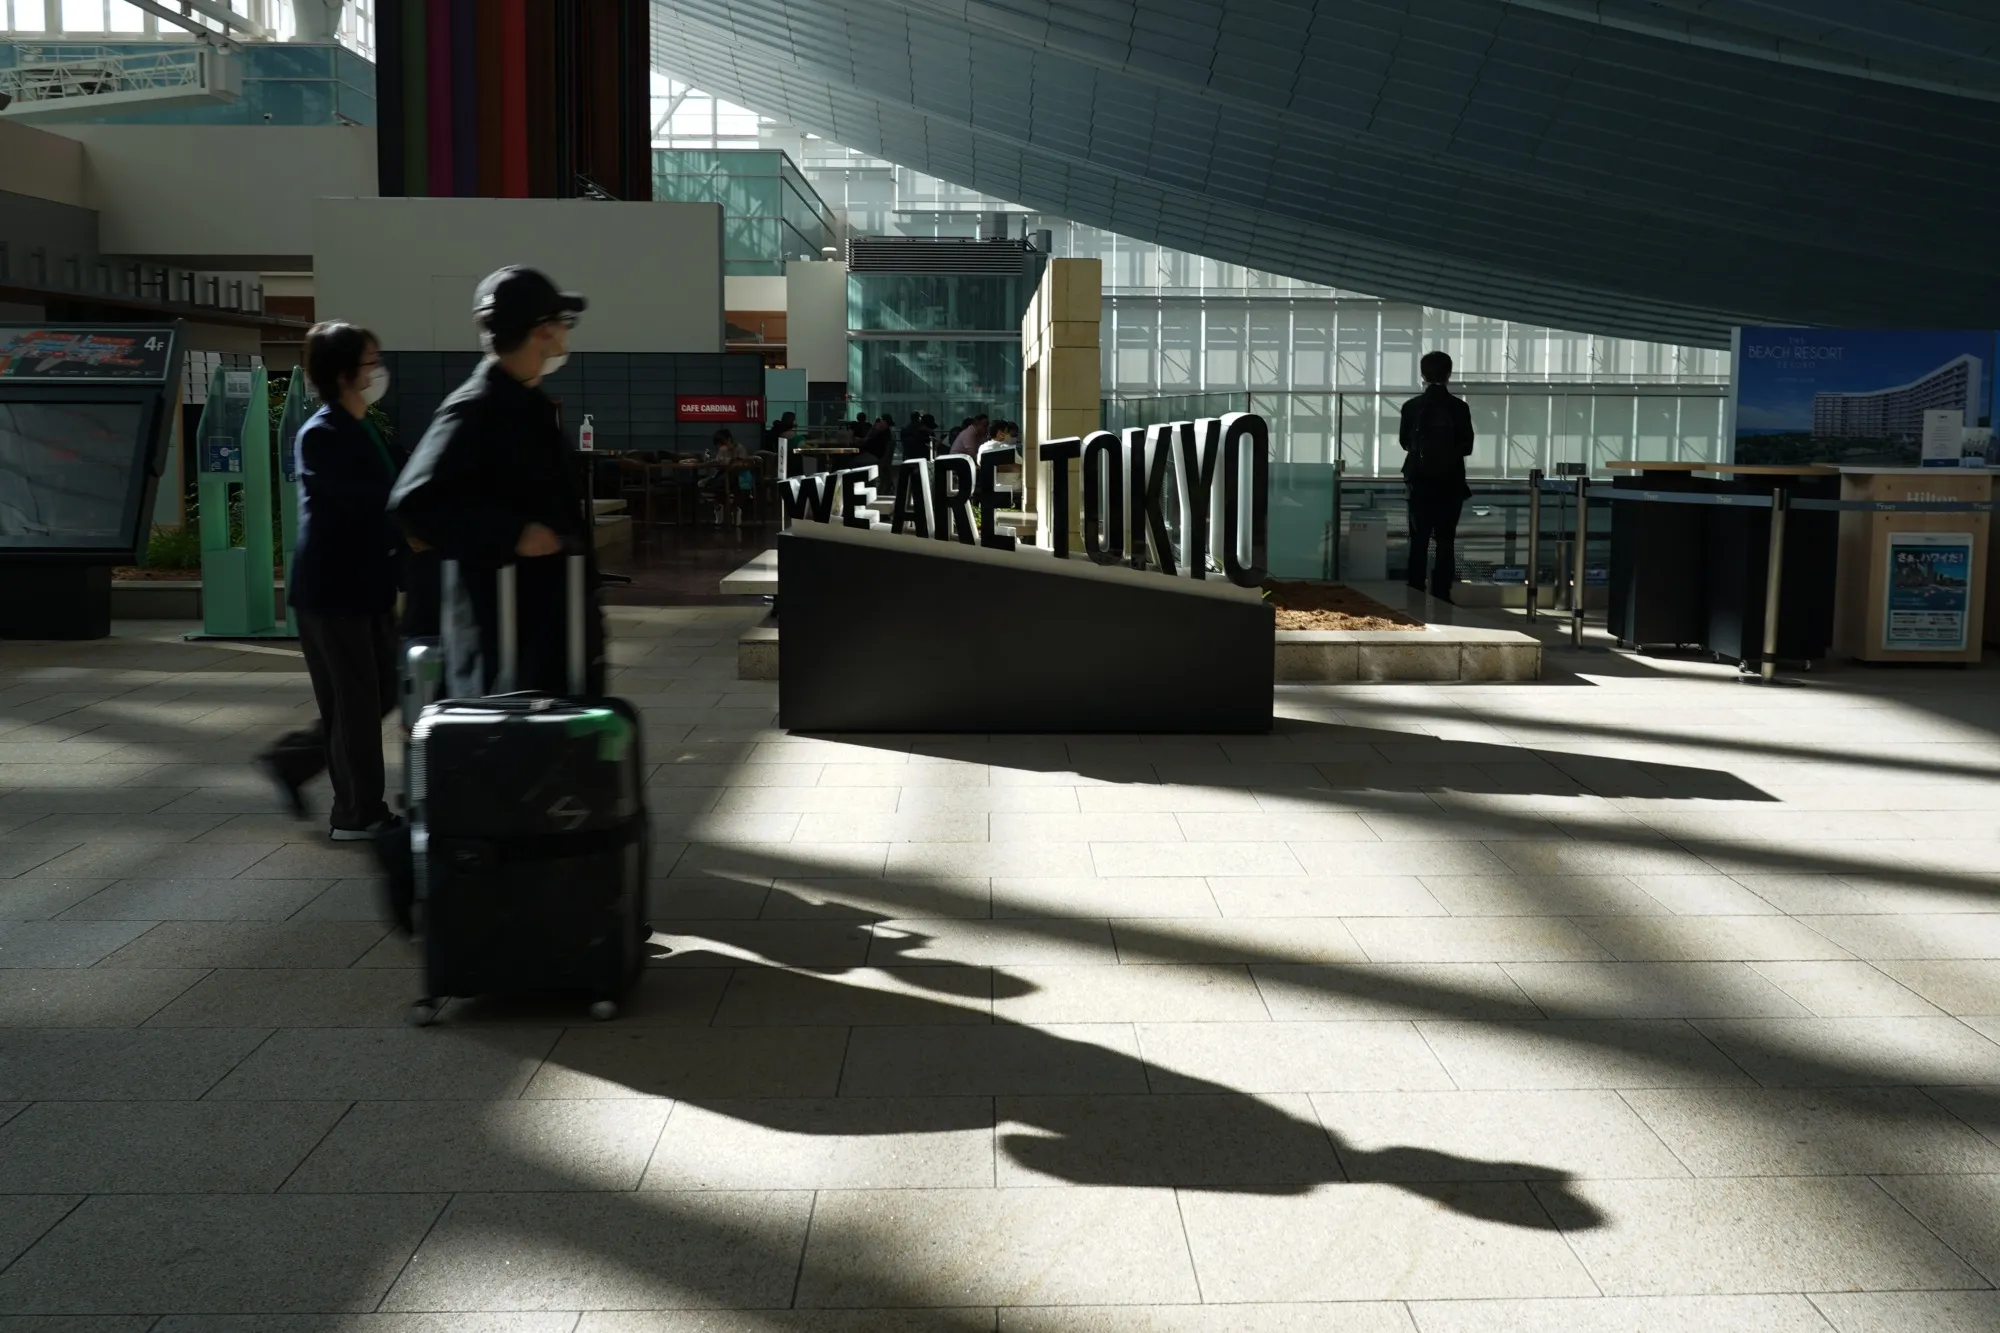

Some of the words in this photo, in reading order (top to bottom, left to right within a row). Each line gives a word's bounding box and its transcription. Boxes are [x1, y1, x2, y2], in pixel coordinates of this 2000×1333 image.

[144, 336, 164, 352] 4F
[1789, 336, 1807, 345] THE
[1748, 345, 1790, 359] BEACH
[1794, 346, 1844, 360] RESORT
[681, 404, 699, 412] CAFE
[700, 404, 736, 412] CARDINAL
[777, 465, 879, 530] WE
[891, 448, 1016, 552] ARE
[1040, 412, 1268, 588] TOKYO
[1906, 491, 1958, 502] Hilton
